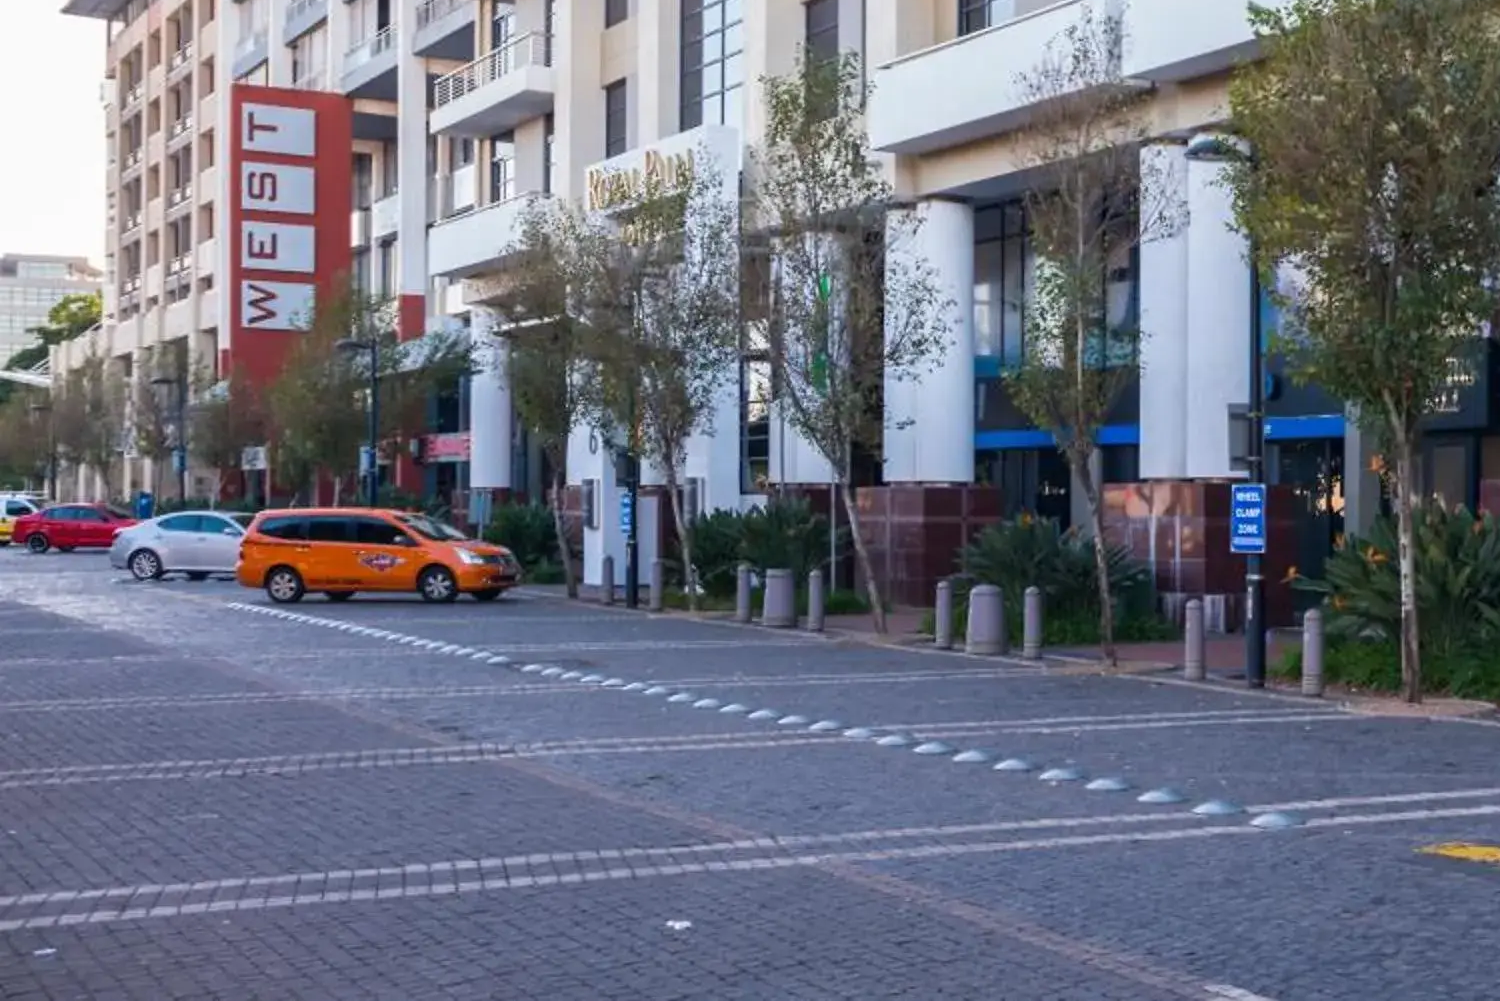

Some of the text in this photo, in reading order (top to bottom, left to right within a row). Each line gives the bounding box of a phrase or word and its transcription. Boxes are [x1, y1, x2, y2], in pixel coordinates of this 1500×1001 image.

[248, 111, 278, 325] WEST
[1236, 508, 1261, 518] CLAMP
[1237, 524, 1259, 534] ZONE
